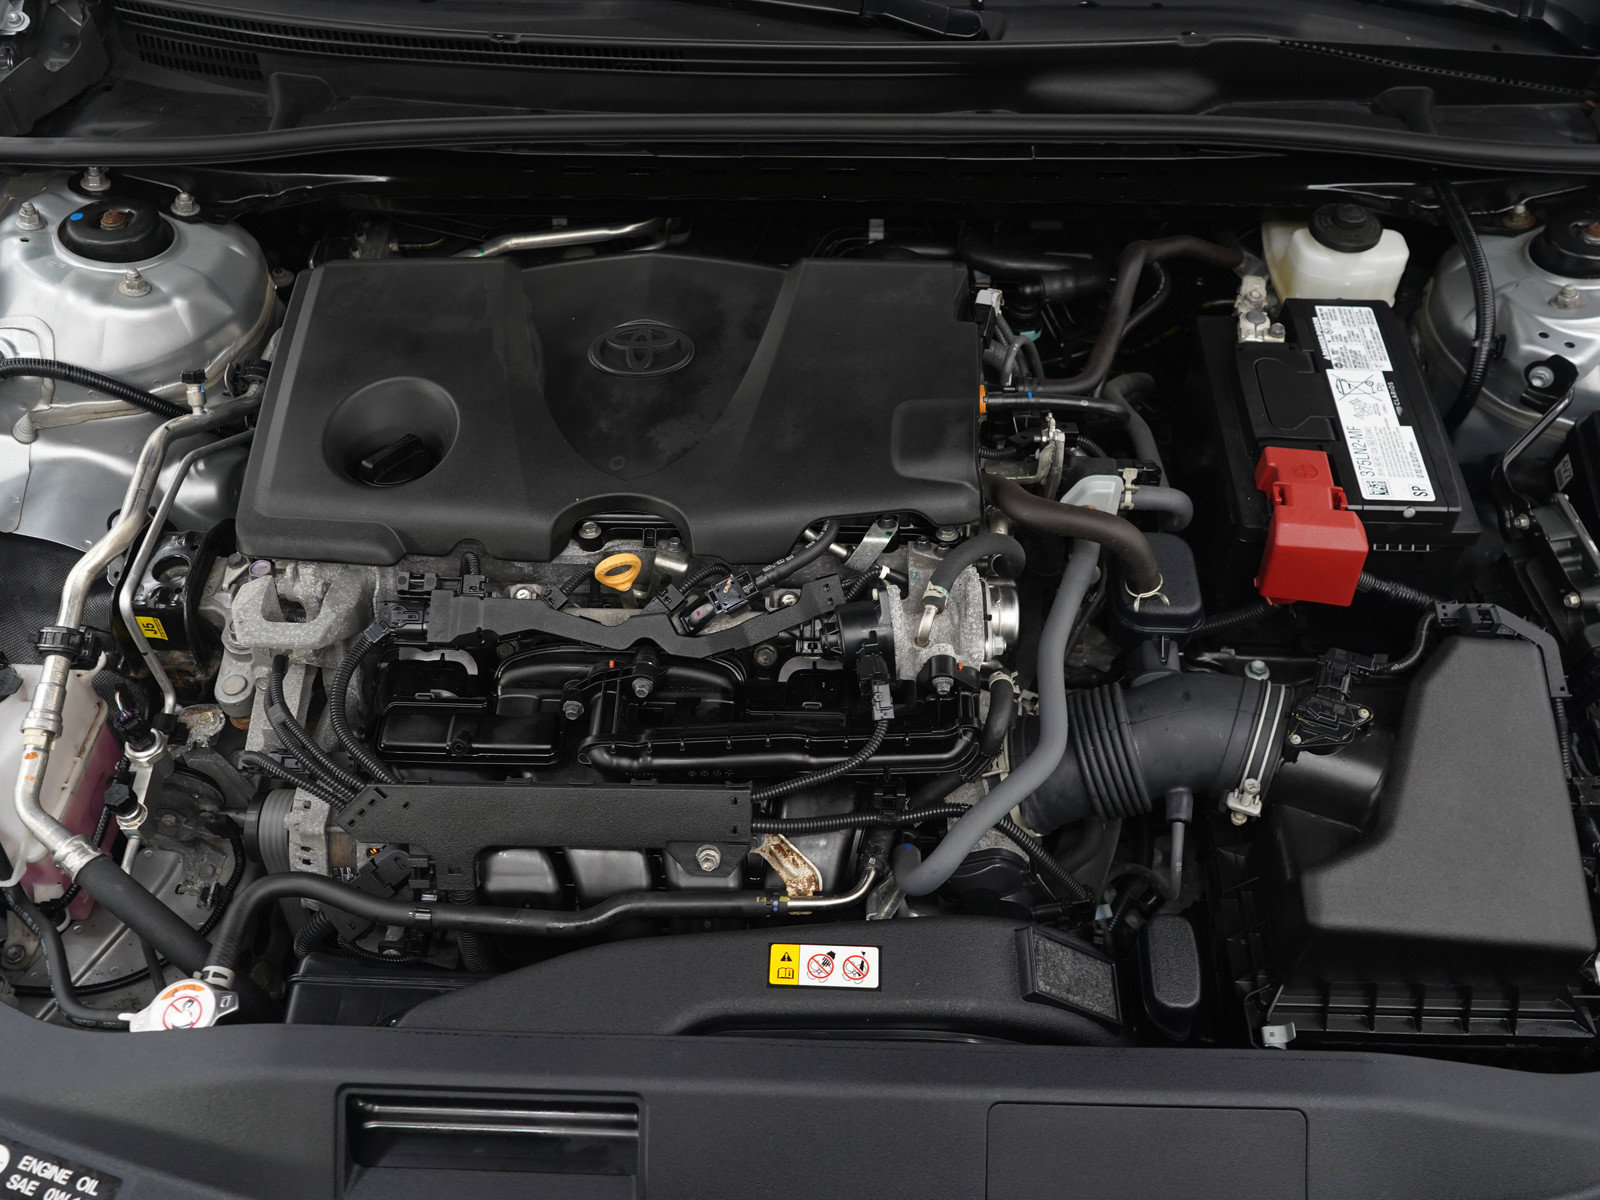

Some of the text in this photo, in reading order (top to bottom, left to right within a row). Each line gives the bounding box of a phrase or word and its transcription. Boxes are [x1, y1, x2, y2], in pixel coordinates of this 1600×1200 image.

[1387, 381, 1401, 406] CLARIOS
[1346, 425, 1375, 477] 375LN2-MF
[1411, 485, 1429, 497] SP
[142, 623, 157, 634] J5
[5, 1174, 41, 1197] SAE
[17, 1155, 101, 1197] ENGINE OIL
